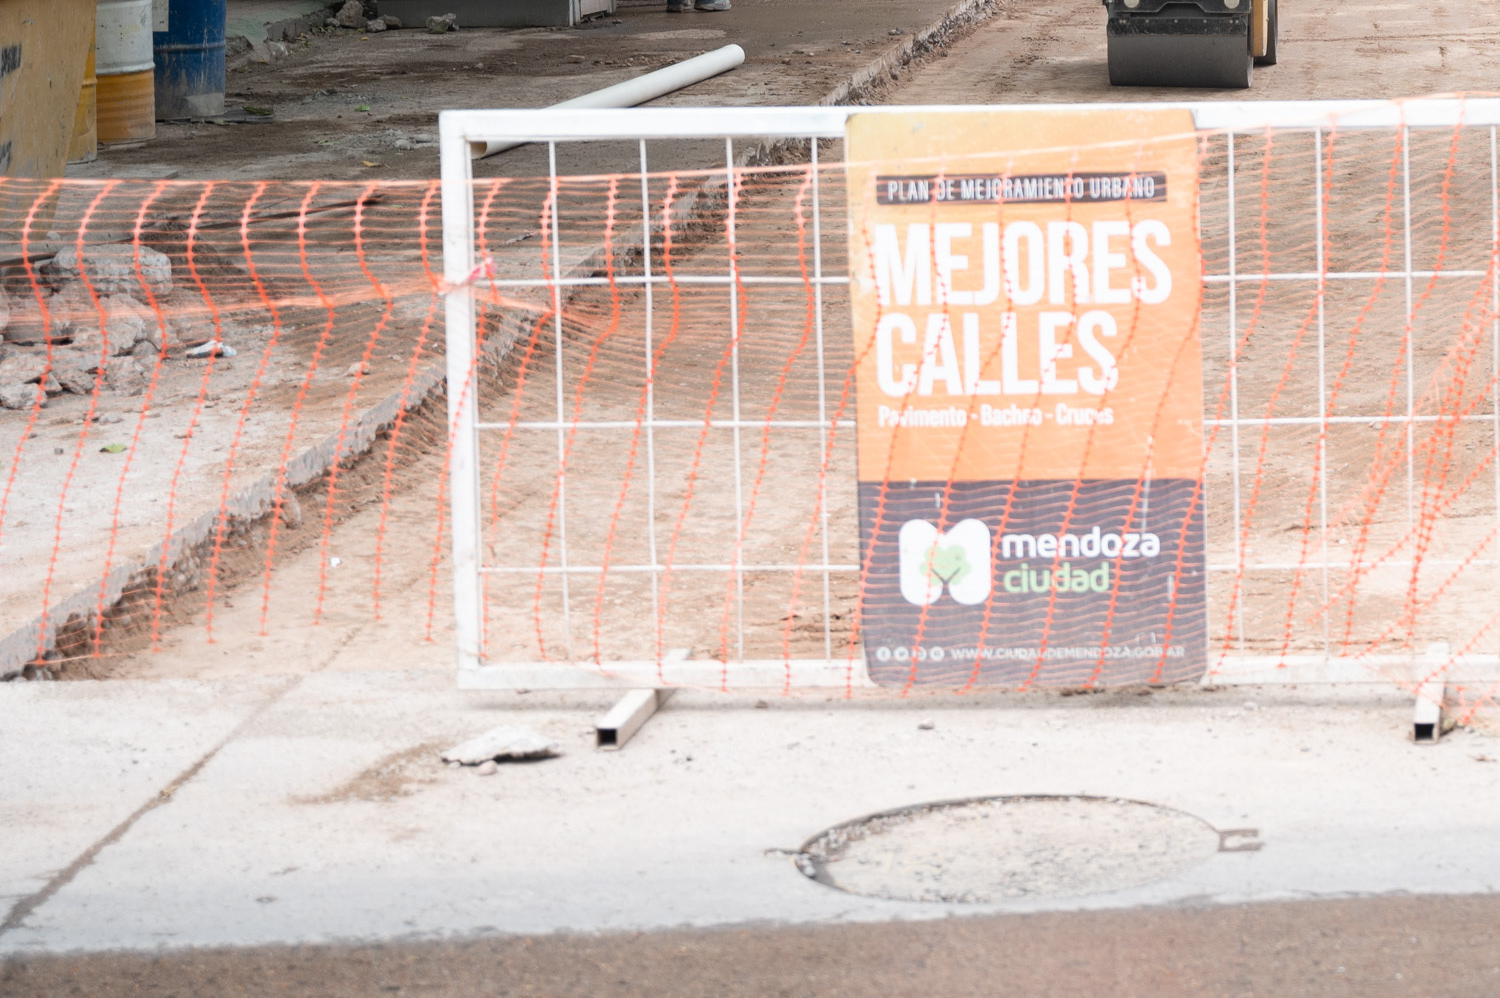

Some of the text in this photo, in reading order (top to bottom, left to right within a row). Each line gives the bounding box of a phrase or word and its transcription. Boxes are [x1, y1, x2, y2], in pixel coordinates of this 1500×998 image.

[887, 179, 929, 201] PLAN
[961, 176, 1085, 200] MEJORAMIENTO
[1089, 175, 1155, 198] URBANO
[873, 219, 1173, 306] MEJORES
[875, 310, 1119, 397] CALLES
[878, 405, 968, 427] Pavimento
[1001, 525, 1161, 559] mendoza
[1002, 561, 1110, 594] ciudad
